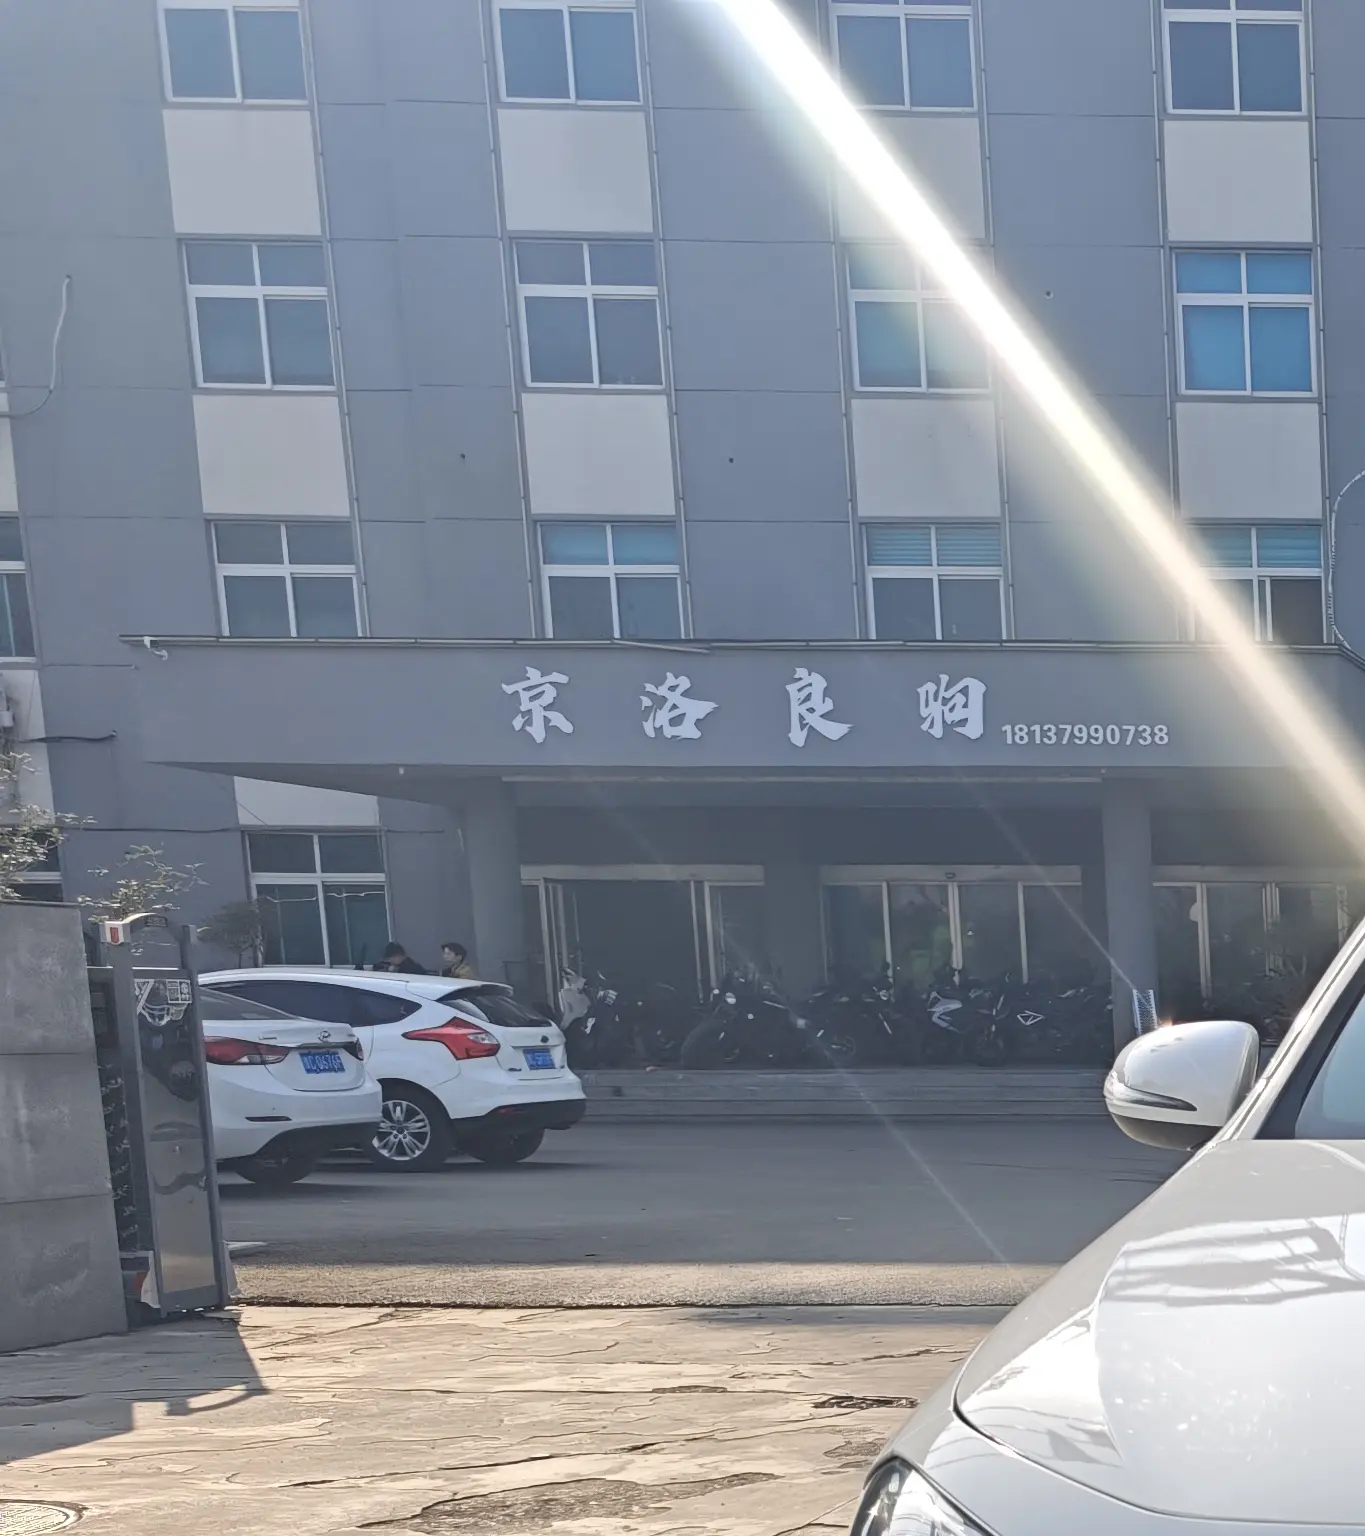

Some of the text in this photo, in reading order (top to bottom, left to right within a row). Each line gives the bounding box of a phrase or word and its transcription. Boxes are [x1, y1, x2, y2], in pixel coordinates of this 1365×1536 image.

[501, 666, 987, 747] 京洛良驹
[1001, 724, 1169, 745] 18137990738
